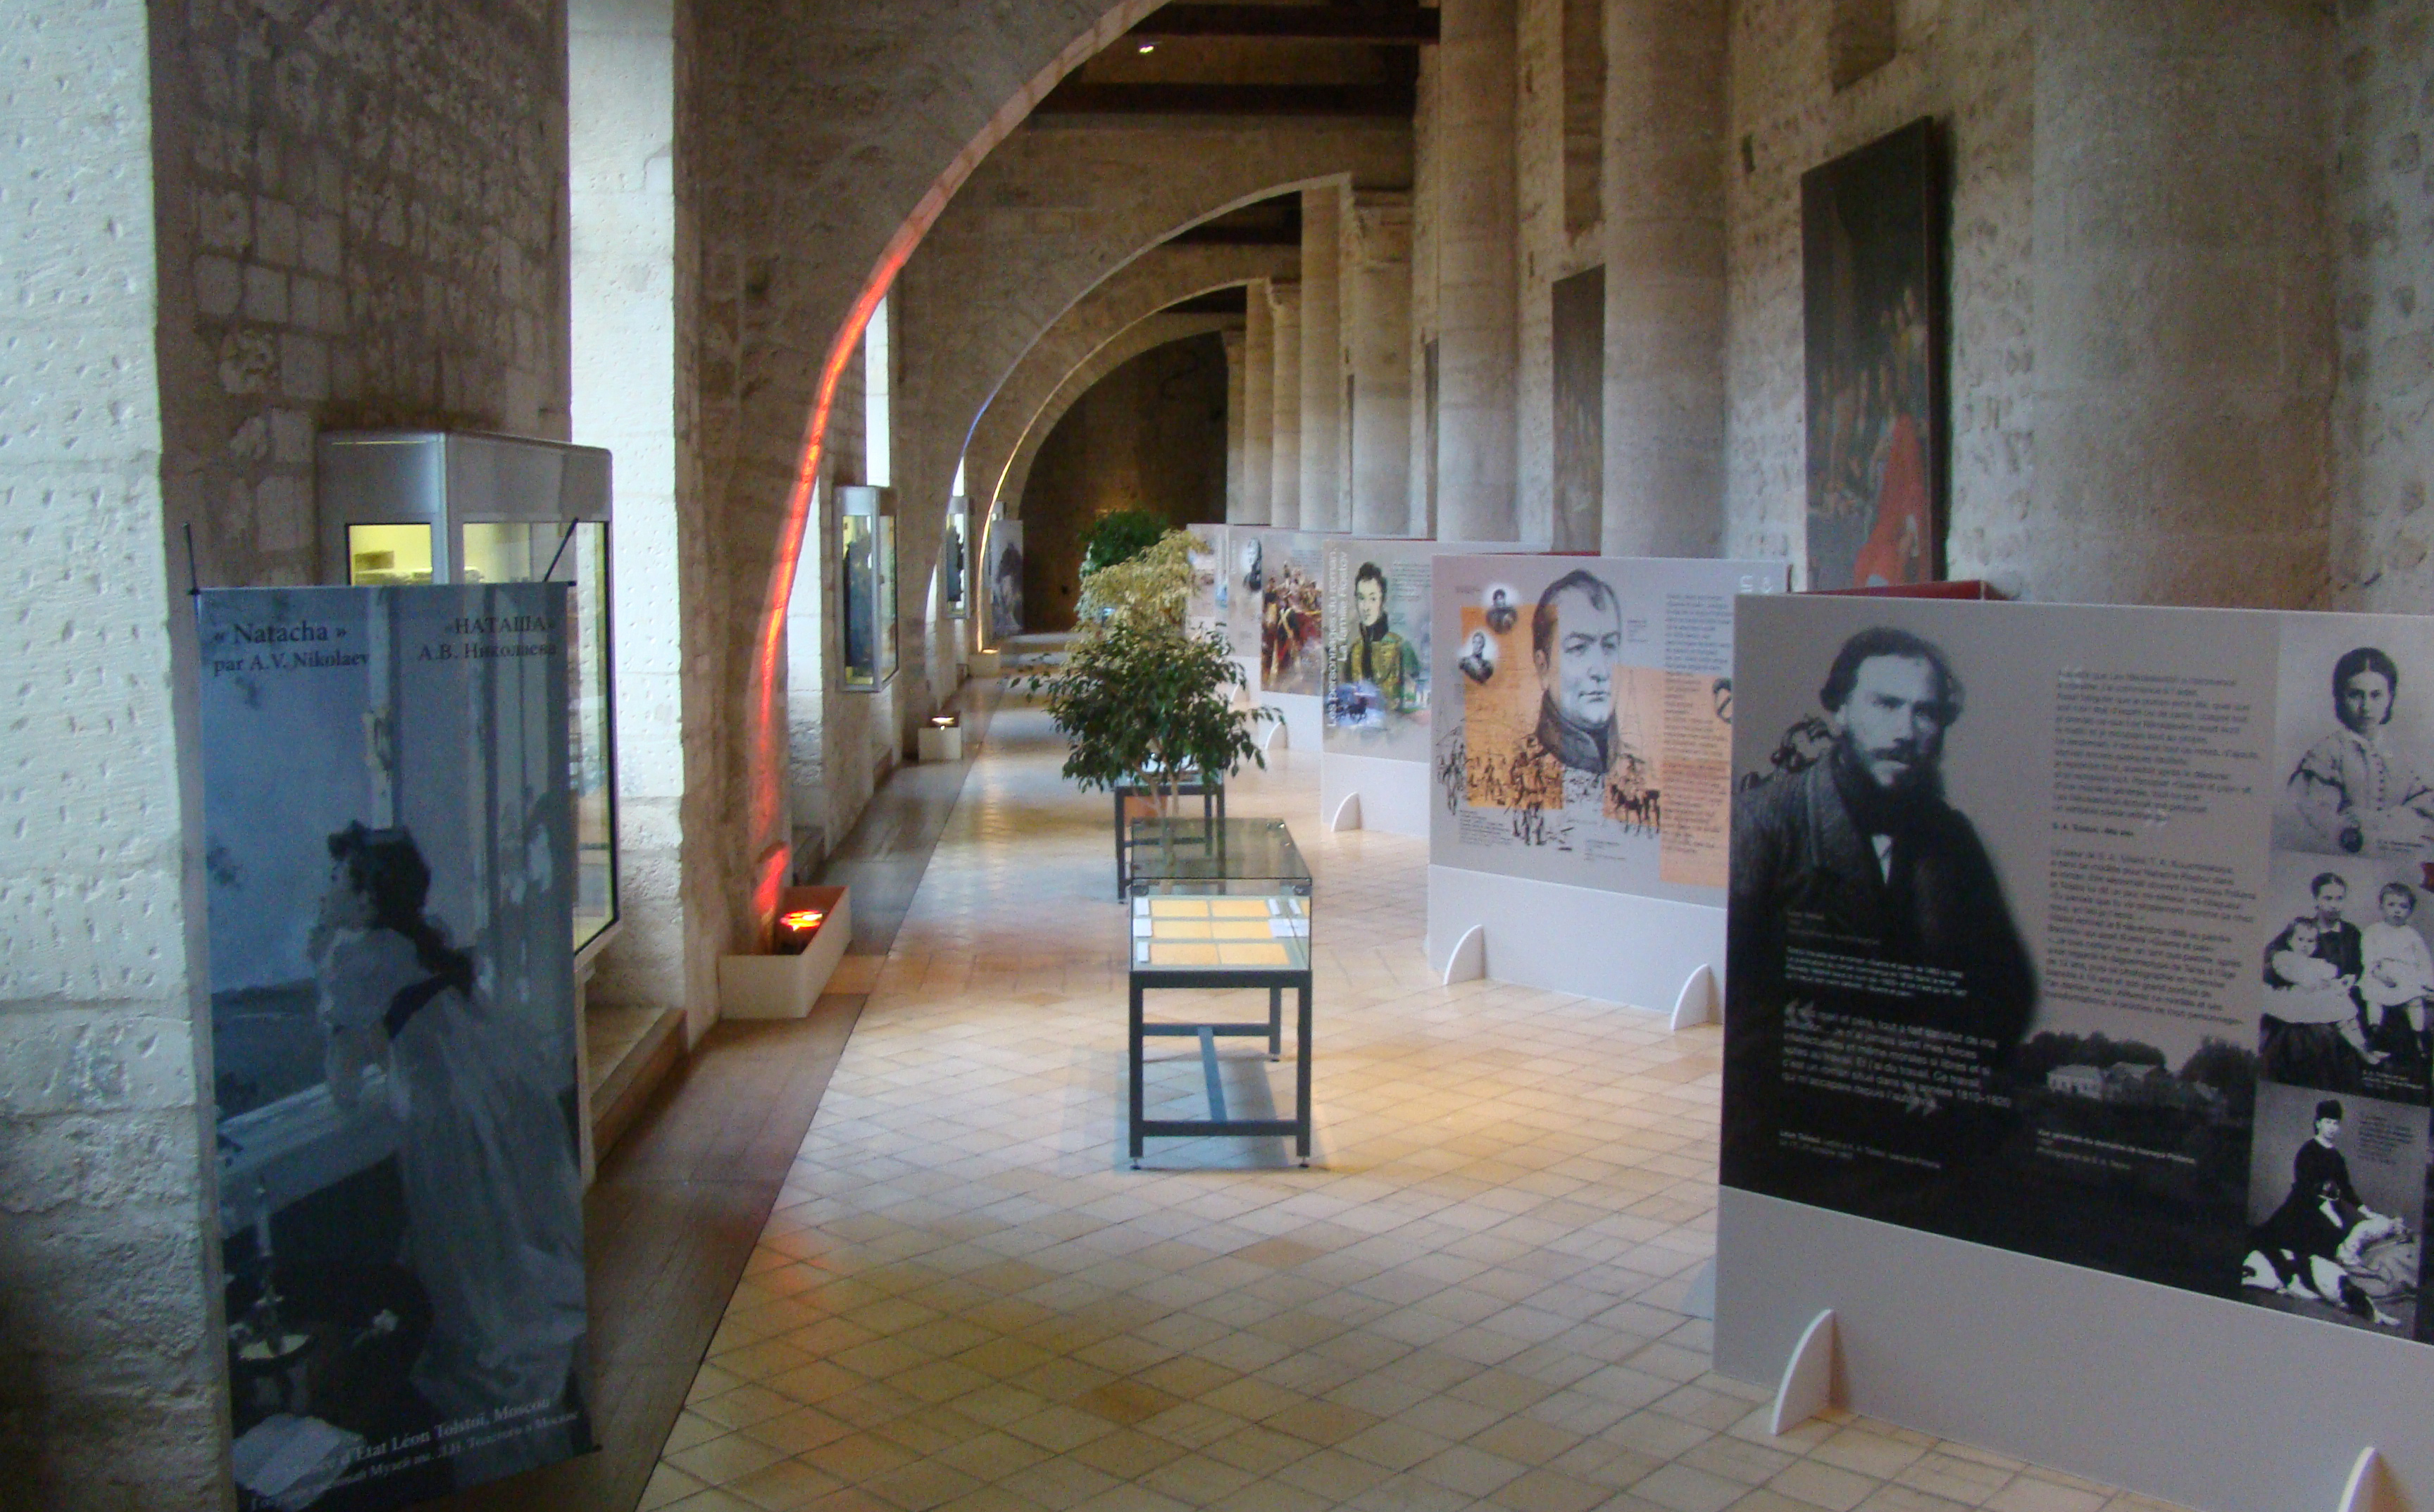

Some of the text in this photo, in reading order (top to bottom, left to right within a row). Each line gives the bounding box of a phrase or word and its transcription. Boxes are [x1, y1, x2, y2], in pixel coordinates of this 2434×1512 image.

[233, 620, 329, 644] Natacha
[213, 659, 244, 677] par
[292, 649, 369, 668] Nikolaev
[392, 1432, 431, 1452] Léon
[494, 1398, 551, 1423] Moscou
